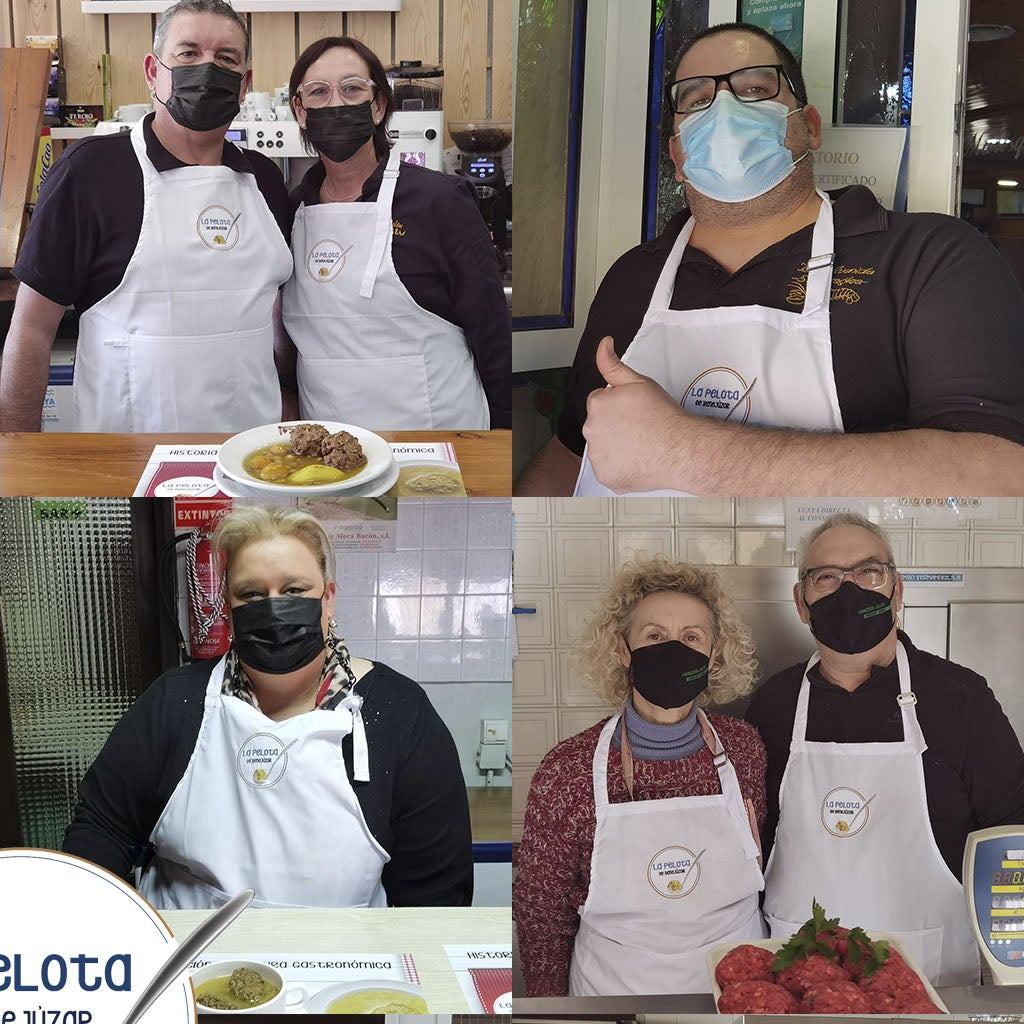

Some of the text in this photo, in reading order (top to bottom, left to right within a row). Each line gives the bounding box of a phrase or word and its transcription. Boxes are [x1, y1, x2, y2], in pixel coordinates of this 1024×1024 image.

[753, 4, 778, 14] aplaza
[779, 2, 802, 10] ahora
[809, 152, 859, 165] ATORIO
[813, 174, 877, 186] ERTIFICADO
[177, 509, 233, 520] EXTINTO
